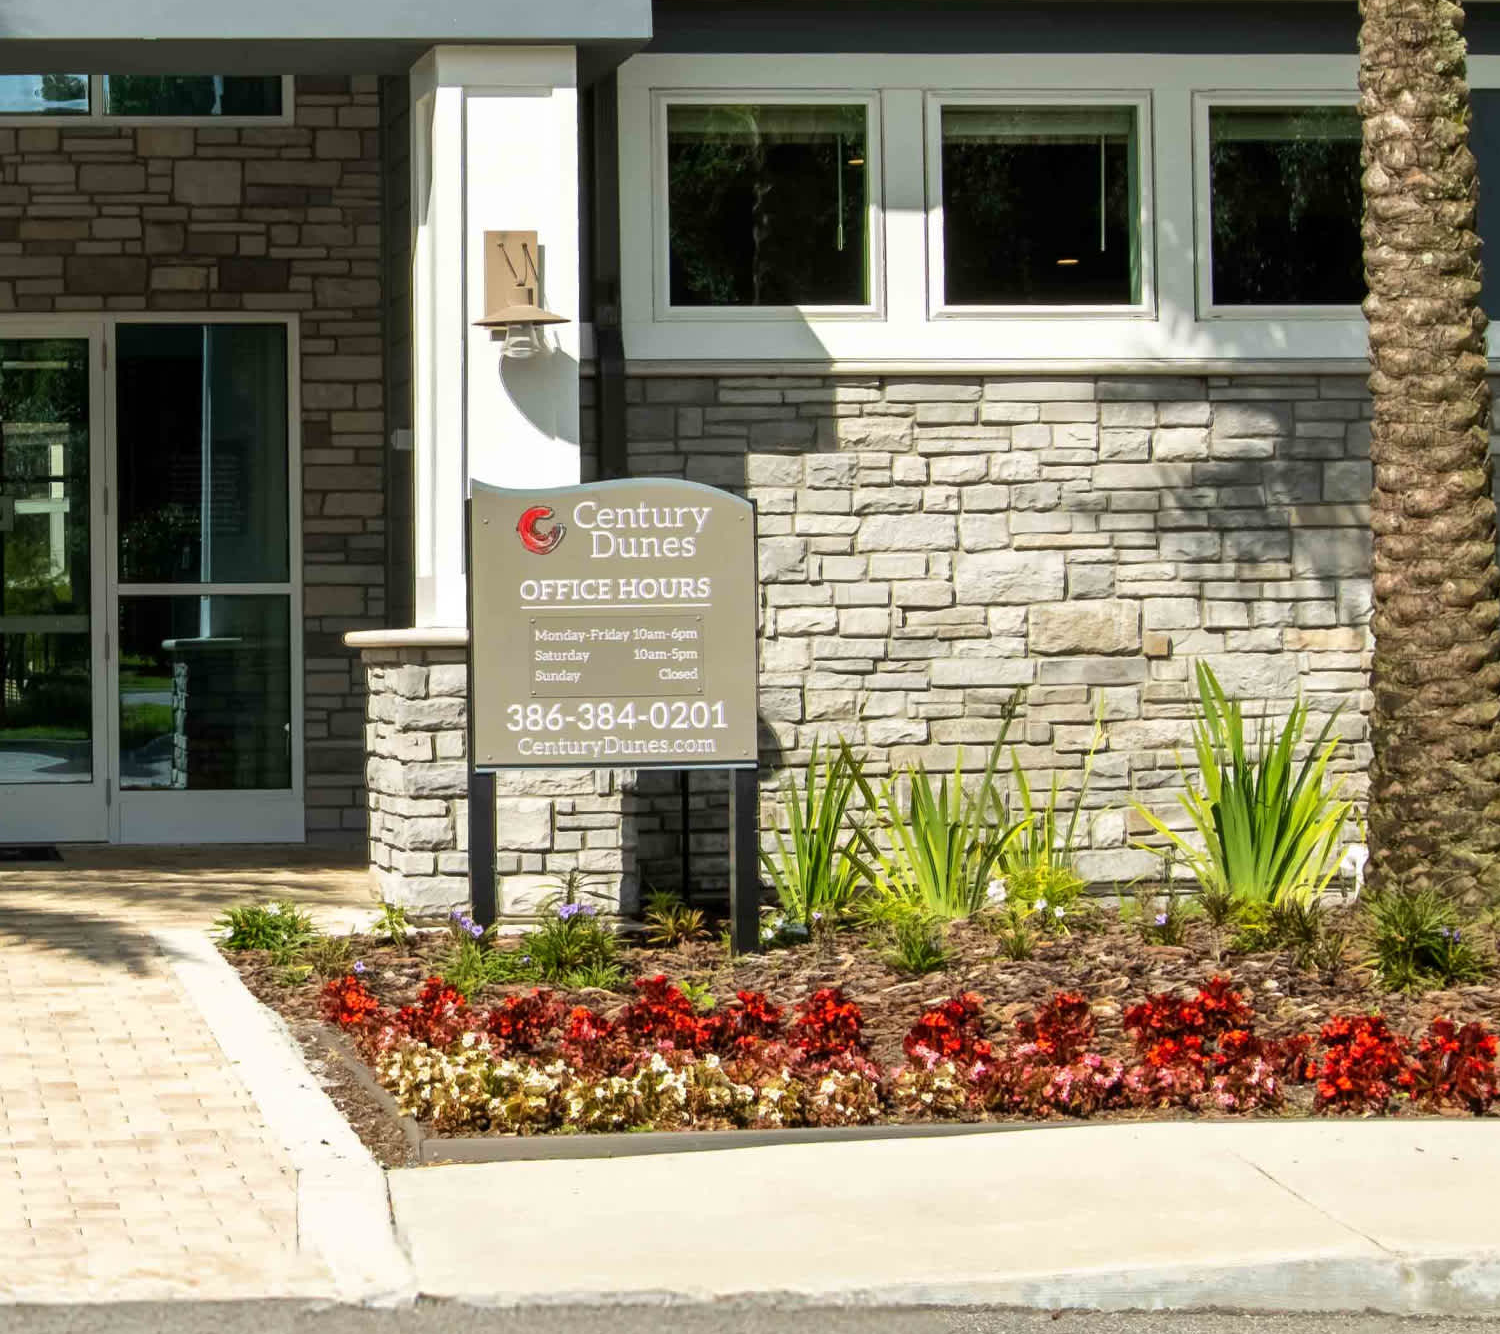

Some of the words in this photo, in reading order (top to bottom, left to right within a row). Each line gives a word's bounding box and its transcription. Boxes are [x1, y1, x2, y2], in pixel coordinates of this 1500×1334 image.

[573, 502, 713, 533] Century
[590, 531, 697, 558] Dunes
[520, 579, 611, 600] OFFICE
[617, 577, 711, 599] HOURS
[535, 628, 630, 642] Monday-Friday
[633, 628, 698, 642] 10am-6pm
[535, 650, 590, 663] Saturday
[634, 648, 698, 662] 10am-5pm
[535, 670, 581, 683] Sunday
[658, 668, 698, 681] Closed
[506, 701, 728, 731] 386-384-0201
[517, 737, 716, 757] CenturyDunes.com
